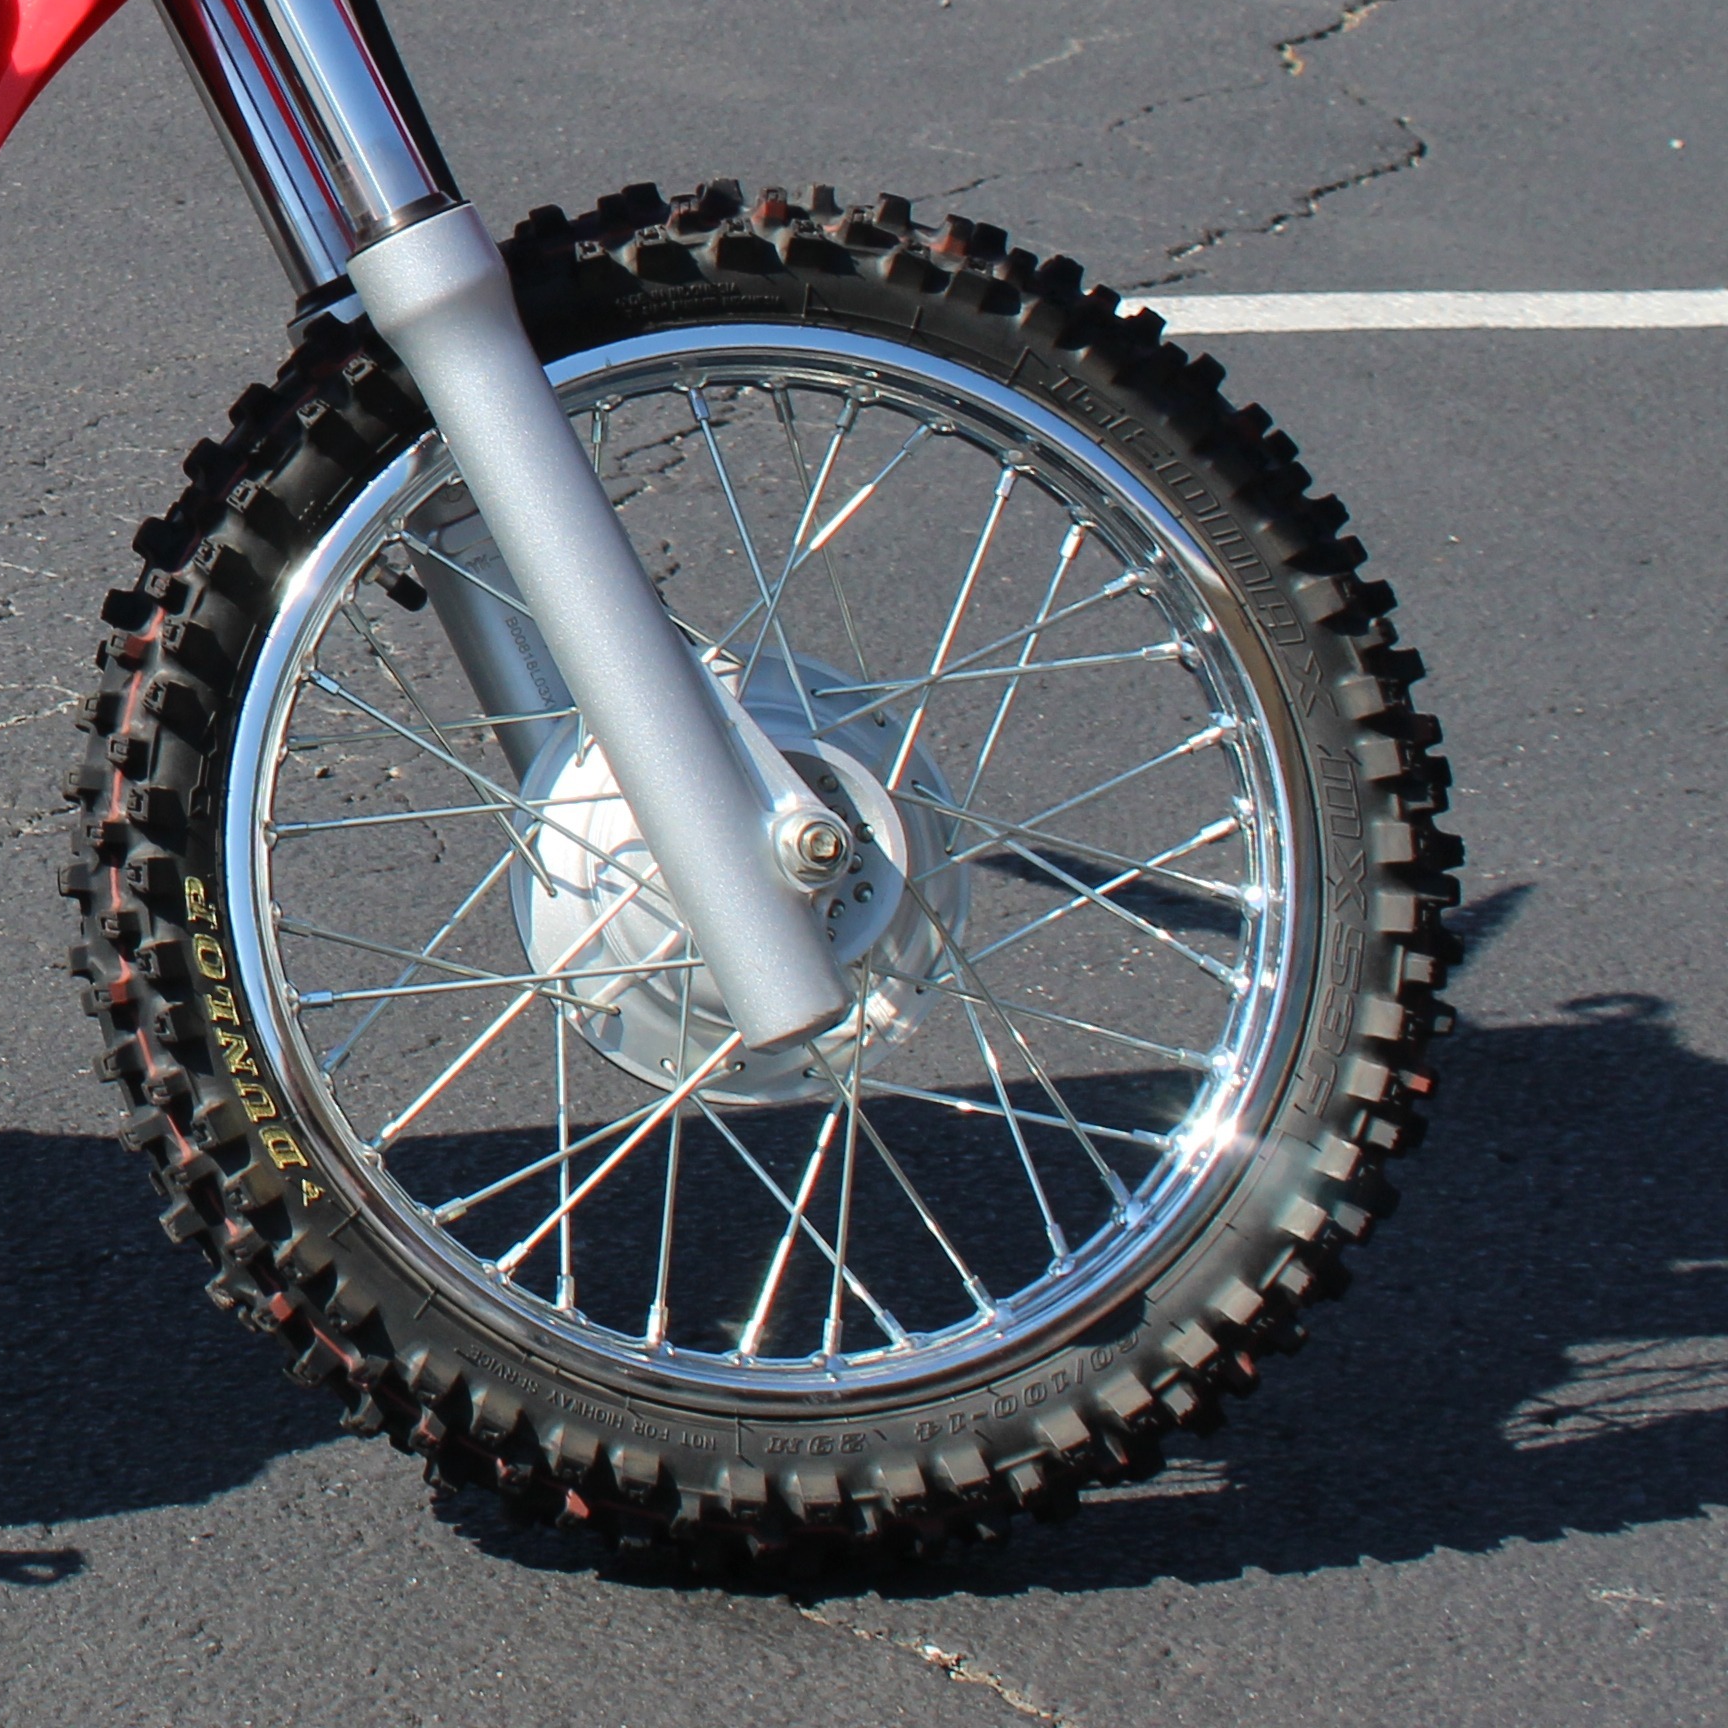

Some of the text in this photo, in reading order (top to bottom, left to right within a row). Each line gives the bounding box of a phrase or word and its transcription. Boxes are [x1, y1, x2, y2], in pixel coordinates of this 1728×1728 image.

[184, 876, 310, 1170] DUNLOP
[469, 1345, 717, 1450] NOT FOR HIGHWAY SERVICE
[767, 1328, 1141, 1456] 60/100-14 29M
